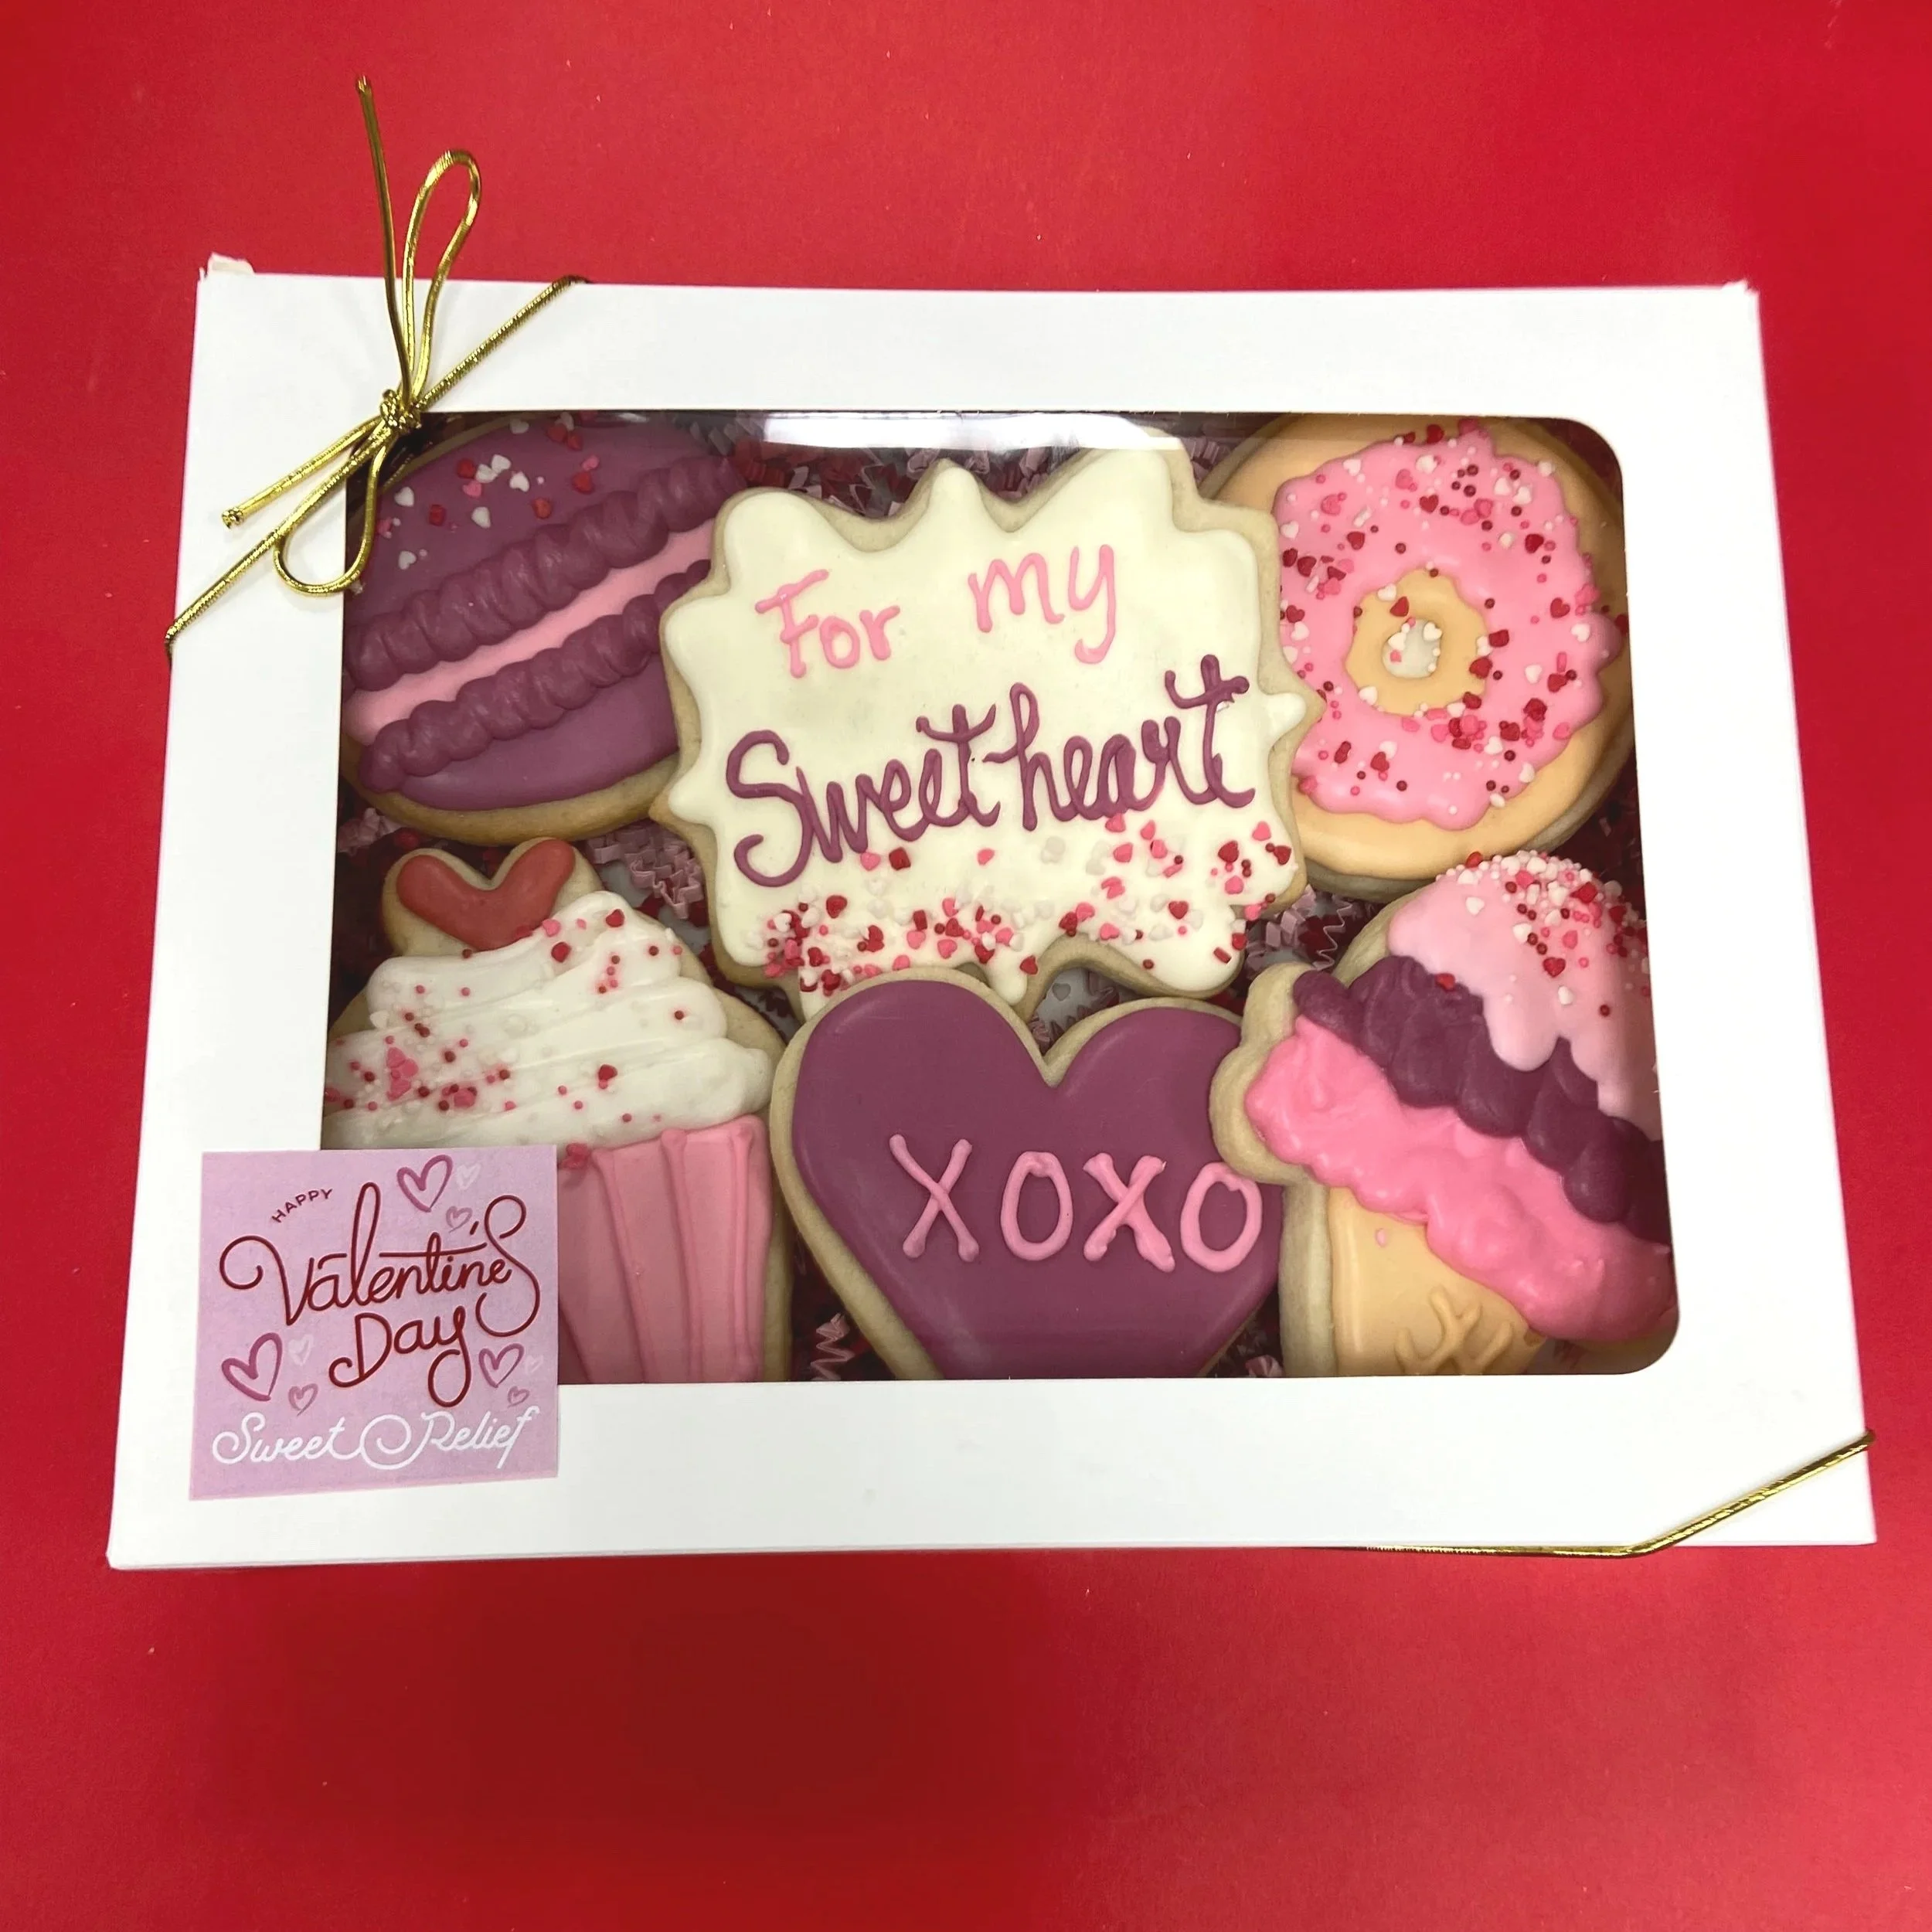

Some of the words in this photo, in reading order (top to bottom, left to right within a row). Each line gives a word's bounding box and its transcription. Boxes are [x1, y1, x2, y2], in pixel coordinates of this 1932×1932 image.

[755, 569, 900, 679] For
[968, 544, 1116, 664] my
[726, 655, 1256, 887] Sweetheart
[271, 1188, 332, 1223] HAPPY
[889, 1134, 1263, 1272] XOXO
[329, 1305, 471, 1407] Day
[212, 1412, 362, 1464] Sweet
[421, 1406, 540, 1469] Relief
